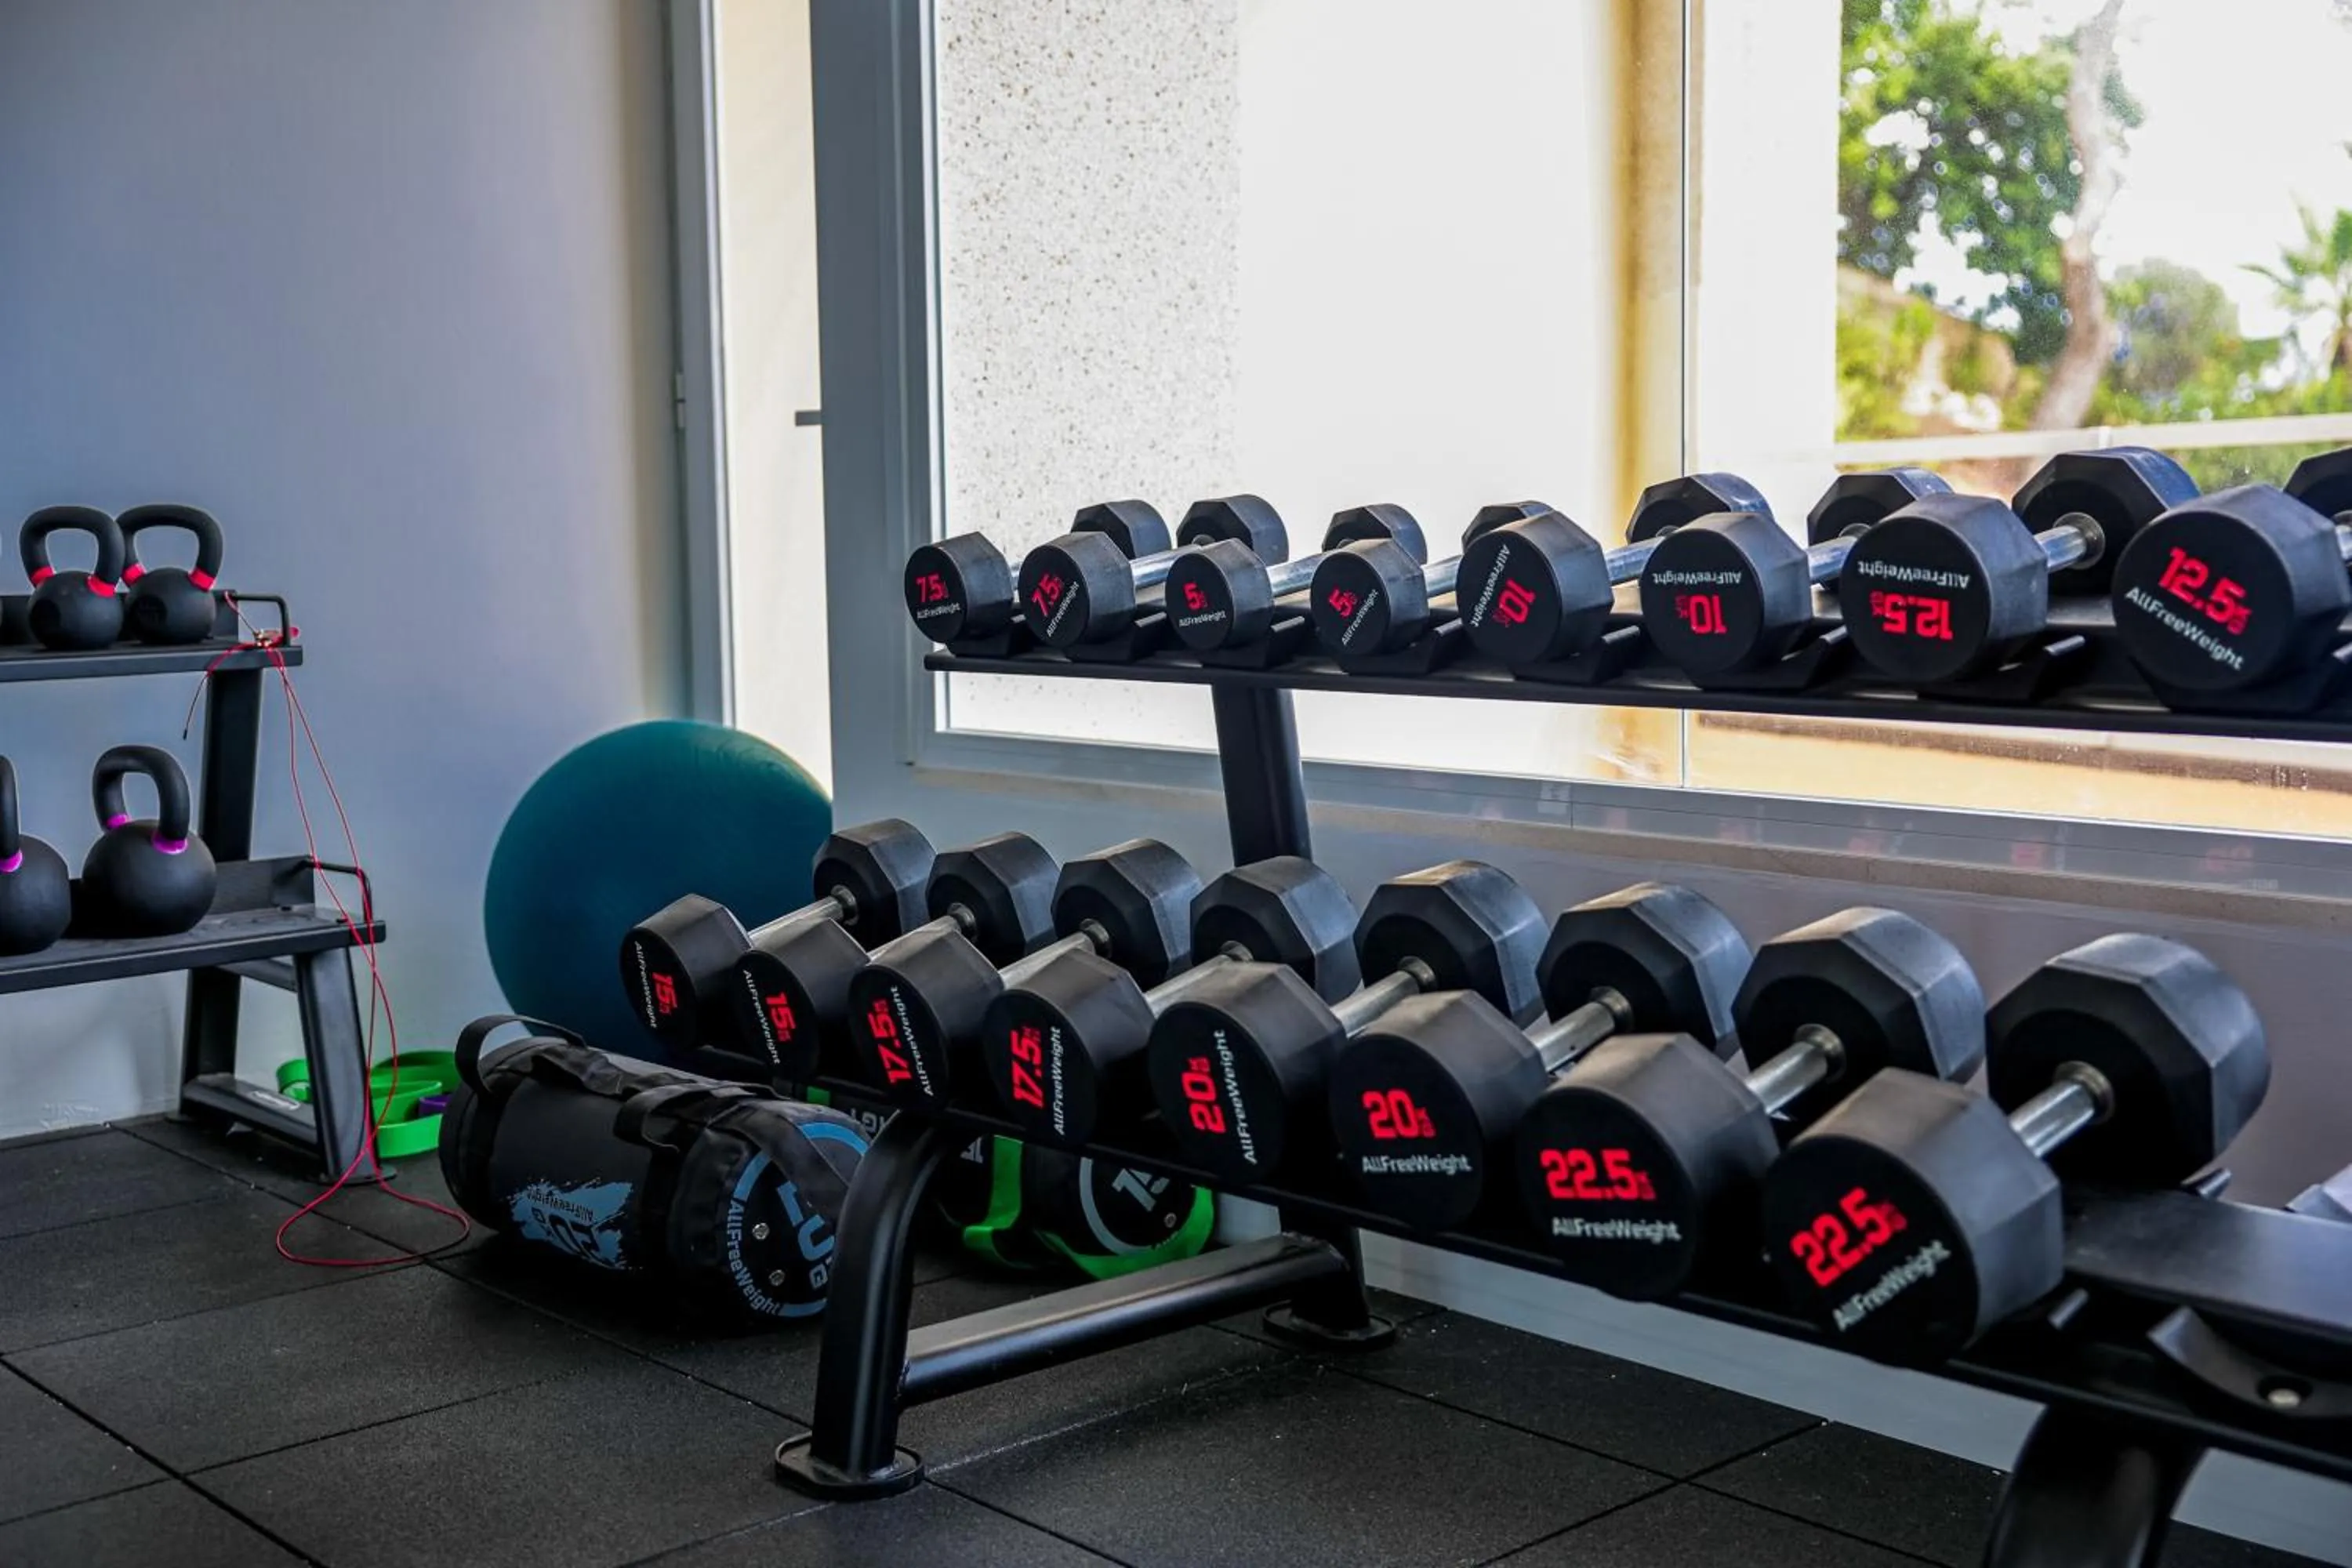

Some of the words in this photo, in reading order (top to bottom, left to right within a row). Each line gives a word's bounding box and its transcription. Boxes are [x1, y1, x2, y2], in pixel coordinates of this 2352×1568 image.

[1184, 583, 1201, 610] 5
[1652, 570, 1742, 586] AllFreeWeight
[1857, 561, 1970, 589] AllFreeWeight
[2158, 546, 2246, 623] 12.5
[1329, 589, 1352, 617] 5
[1499, 579, 1536, 624] 10
[1690, 593, 1728, 634] 10
[1882, 592, 1954, 641] 12.5
[2125, 586, 2245, 670] AllFreeWeight
[765, 992, 796, 1029] 15
[867, 1011, 912, 1084] 17.5
[891, 985, 934, 1096] AllFreeWeight
[1011, 1029, 1044, 1109] 17.5
[1050, 1025, 1065, 1136] AllFreeWeight
[1181, 1071, 1227, 1134] 20
[1214, 1029, 1258, 1165] AllFreeWeight
[1362, 1089, 1419, 1139] 20
[1361, 1153, 1473, 1176] AllFreeWeight
[1540, 1148, 1639, 1200] 22.5
[727, 1197, 782, 1316] AllFreeWeight
[1552, 1216, 1683, 1245] AllFreeWeight
[1790, 1186, 1893, 1287] 22.5
[1832, 1240, 1951, 1332] AllFreeWeight
